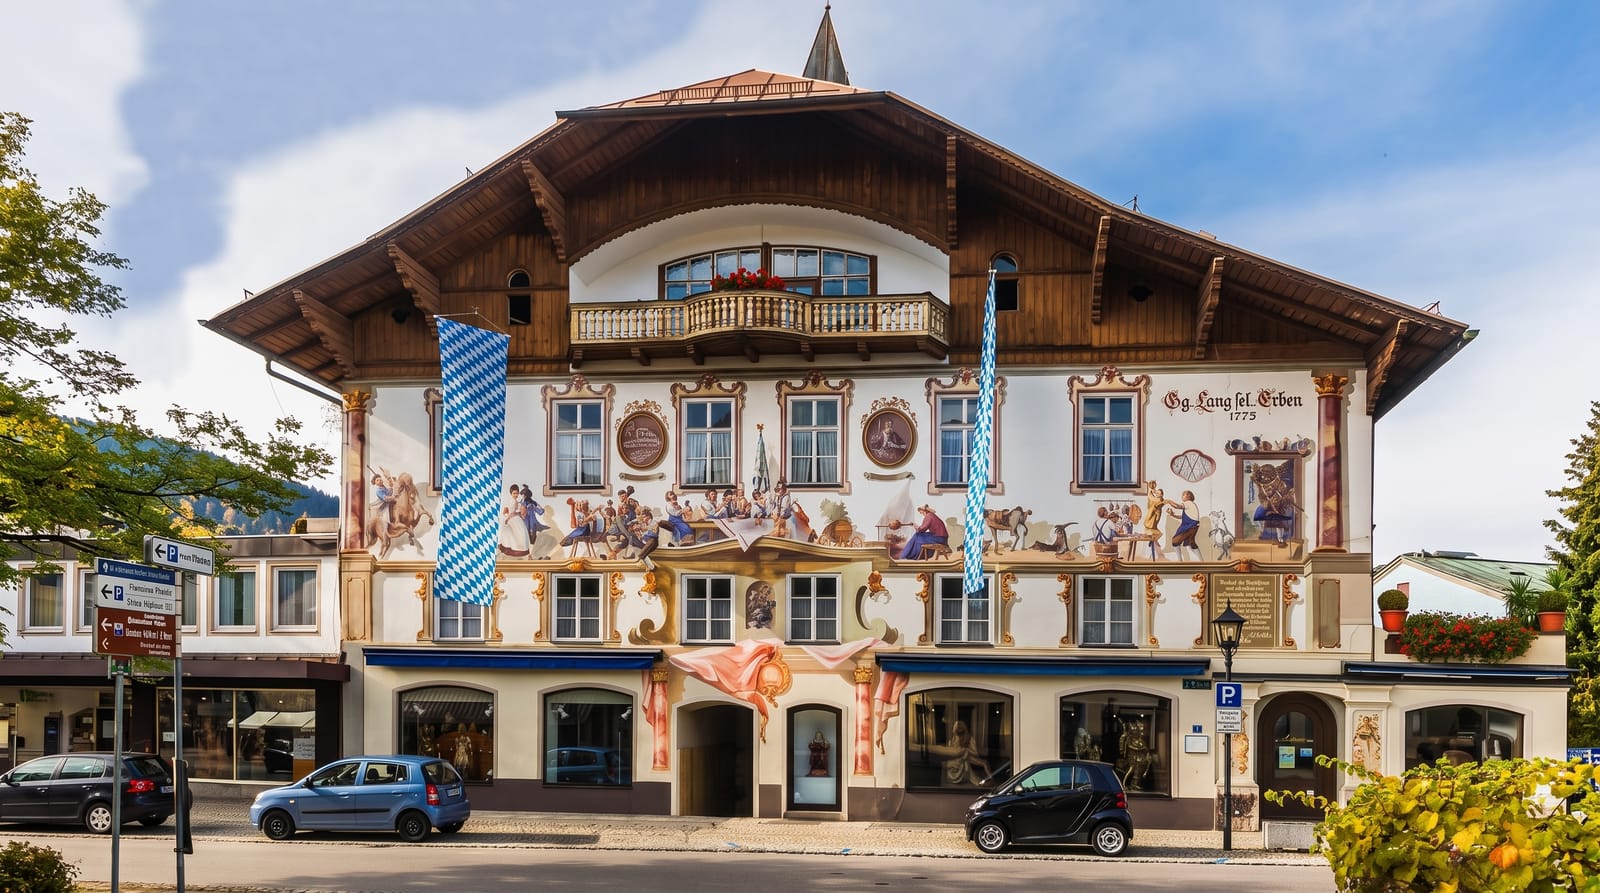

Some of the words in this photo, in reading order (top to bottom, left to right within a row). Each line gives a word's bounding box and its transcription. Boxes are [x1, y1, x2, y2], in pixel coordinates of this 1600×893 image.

[1195, 390, 1231, 413] Lang
[1258, 390, 1302, 407] Erben
[1230, 411, 1257, 421] 1775
[169, 546, 176, 560] P
[115, 587, 122, 600] P
[1222, 686, 1236, 704] P
